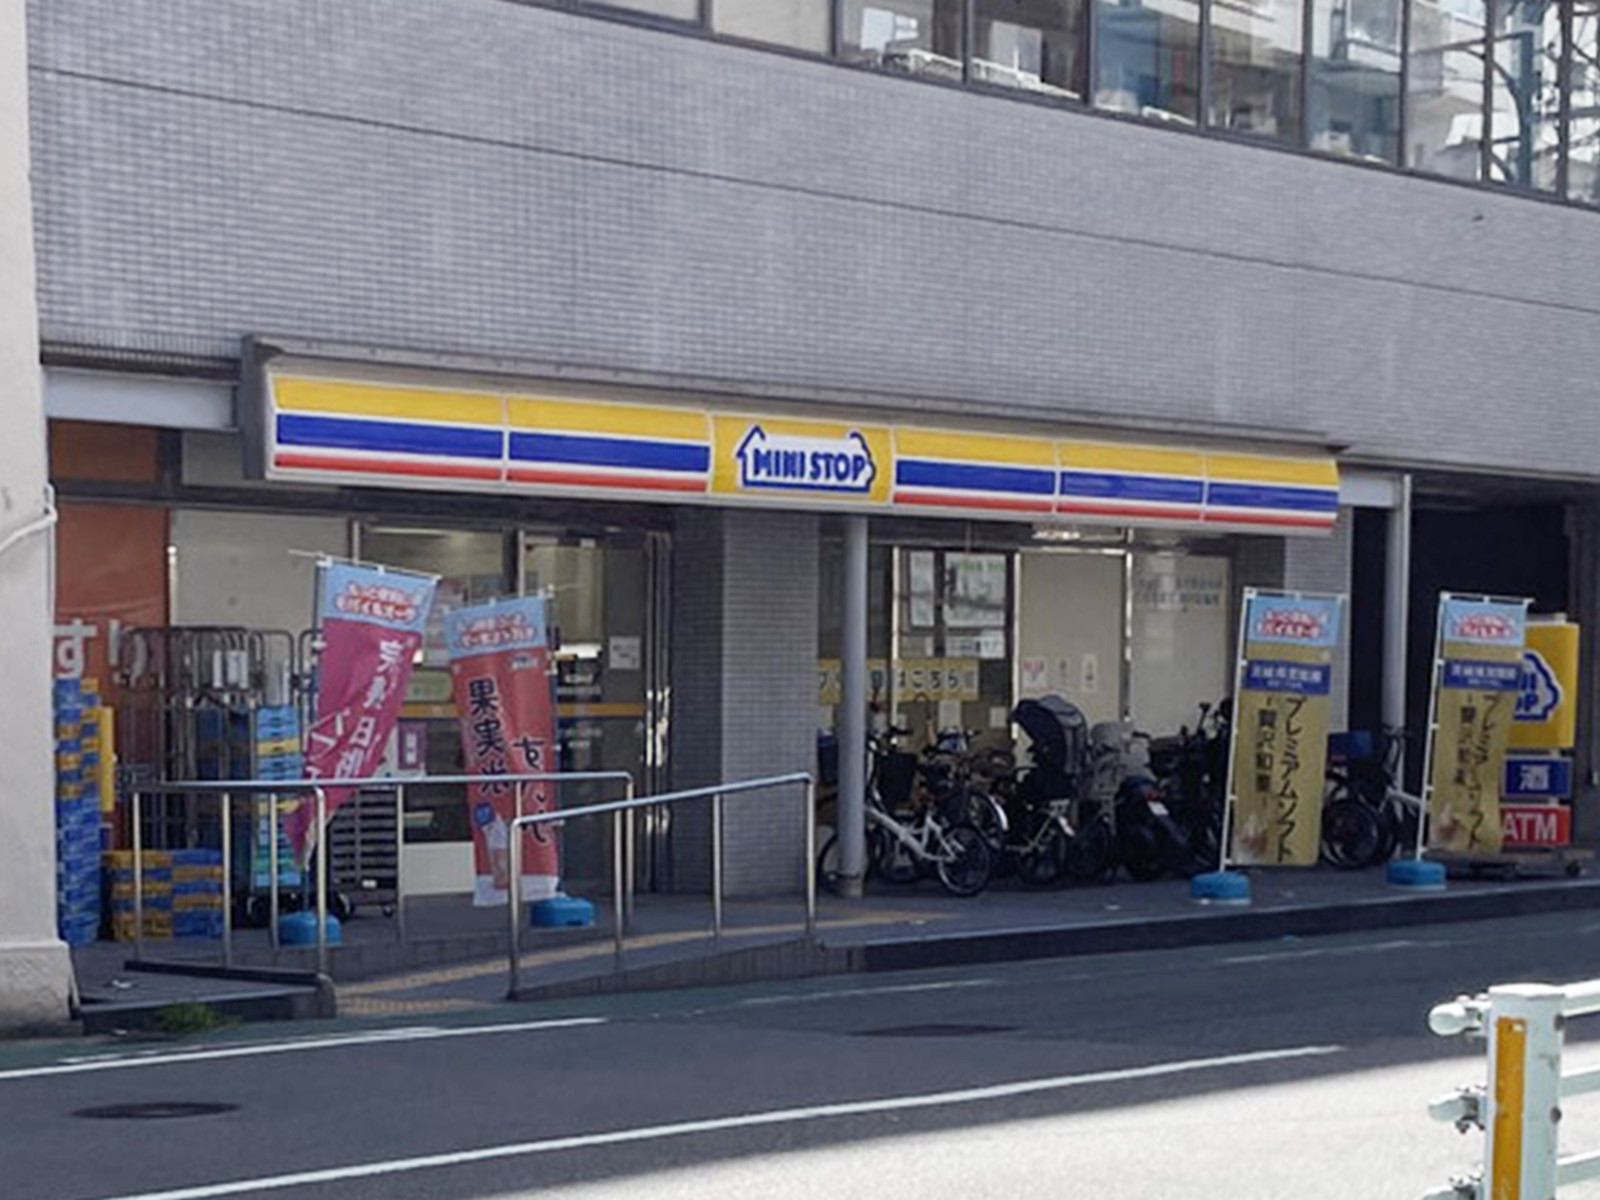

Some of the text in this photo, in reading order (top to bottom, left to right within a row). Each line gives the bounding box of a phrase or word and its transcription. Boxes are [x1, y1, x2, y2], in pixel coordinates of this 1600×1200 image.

[753, 449, 867, 481] MINI STOP
[1502, 812, 1558, 842] ATM
